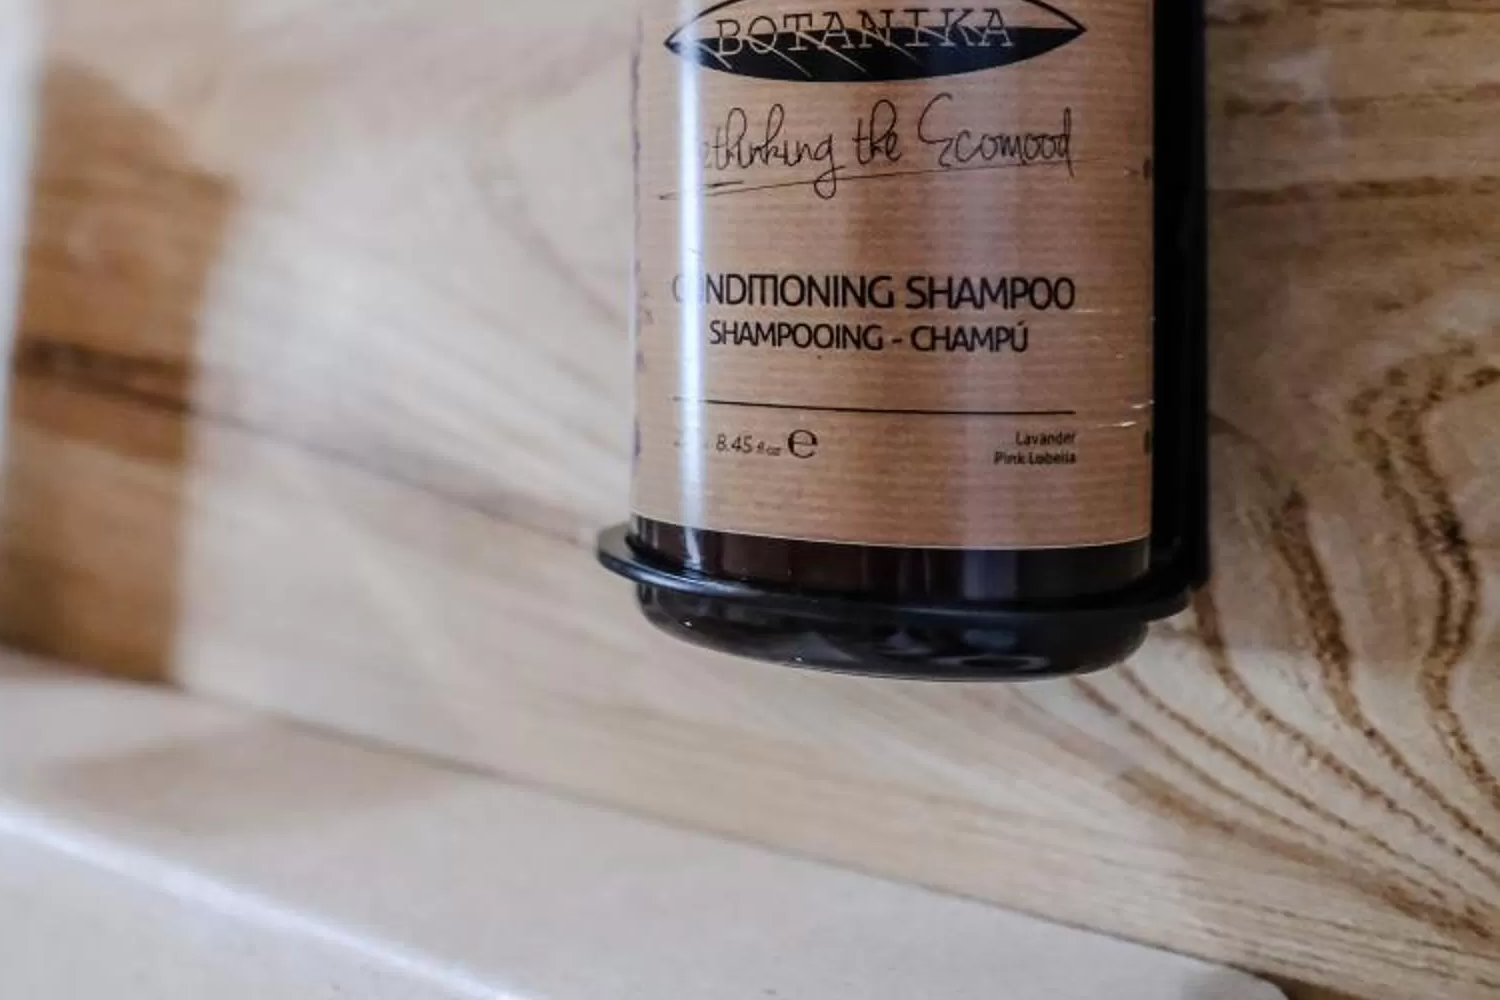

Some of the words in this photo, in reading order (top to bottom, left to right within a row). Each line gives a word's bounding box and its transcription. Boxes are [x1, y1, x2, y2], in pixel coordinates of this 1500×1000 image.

[715, 7, 1015, 56] BOTANIKA
[852, 99, 901, 165] the
[917, 92, 1074, 178] Ecomood
[671, 273, 894, 309] CNDITIONING
[904, 276, 1075, 311] SHAMPOO
[708, 319, 883, 351] SHAMPOOING
[910, 320, 1029, 353] CHAMPÚ
[715, 433, 753, 454] 8.45
